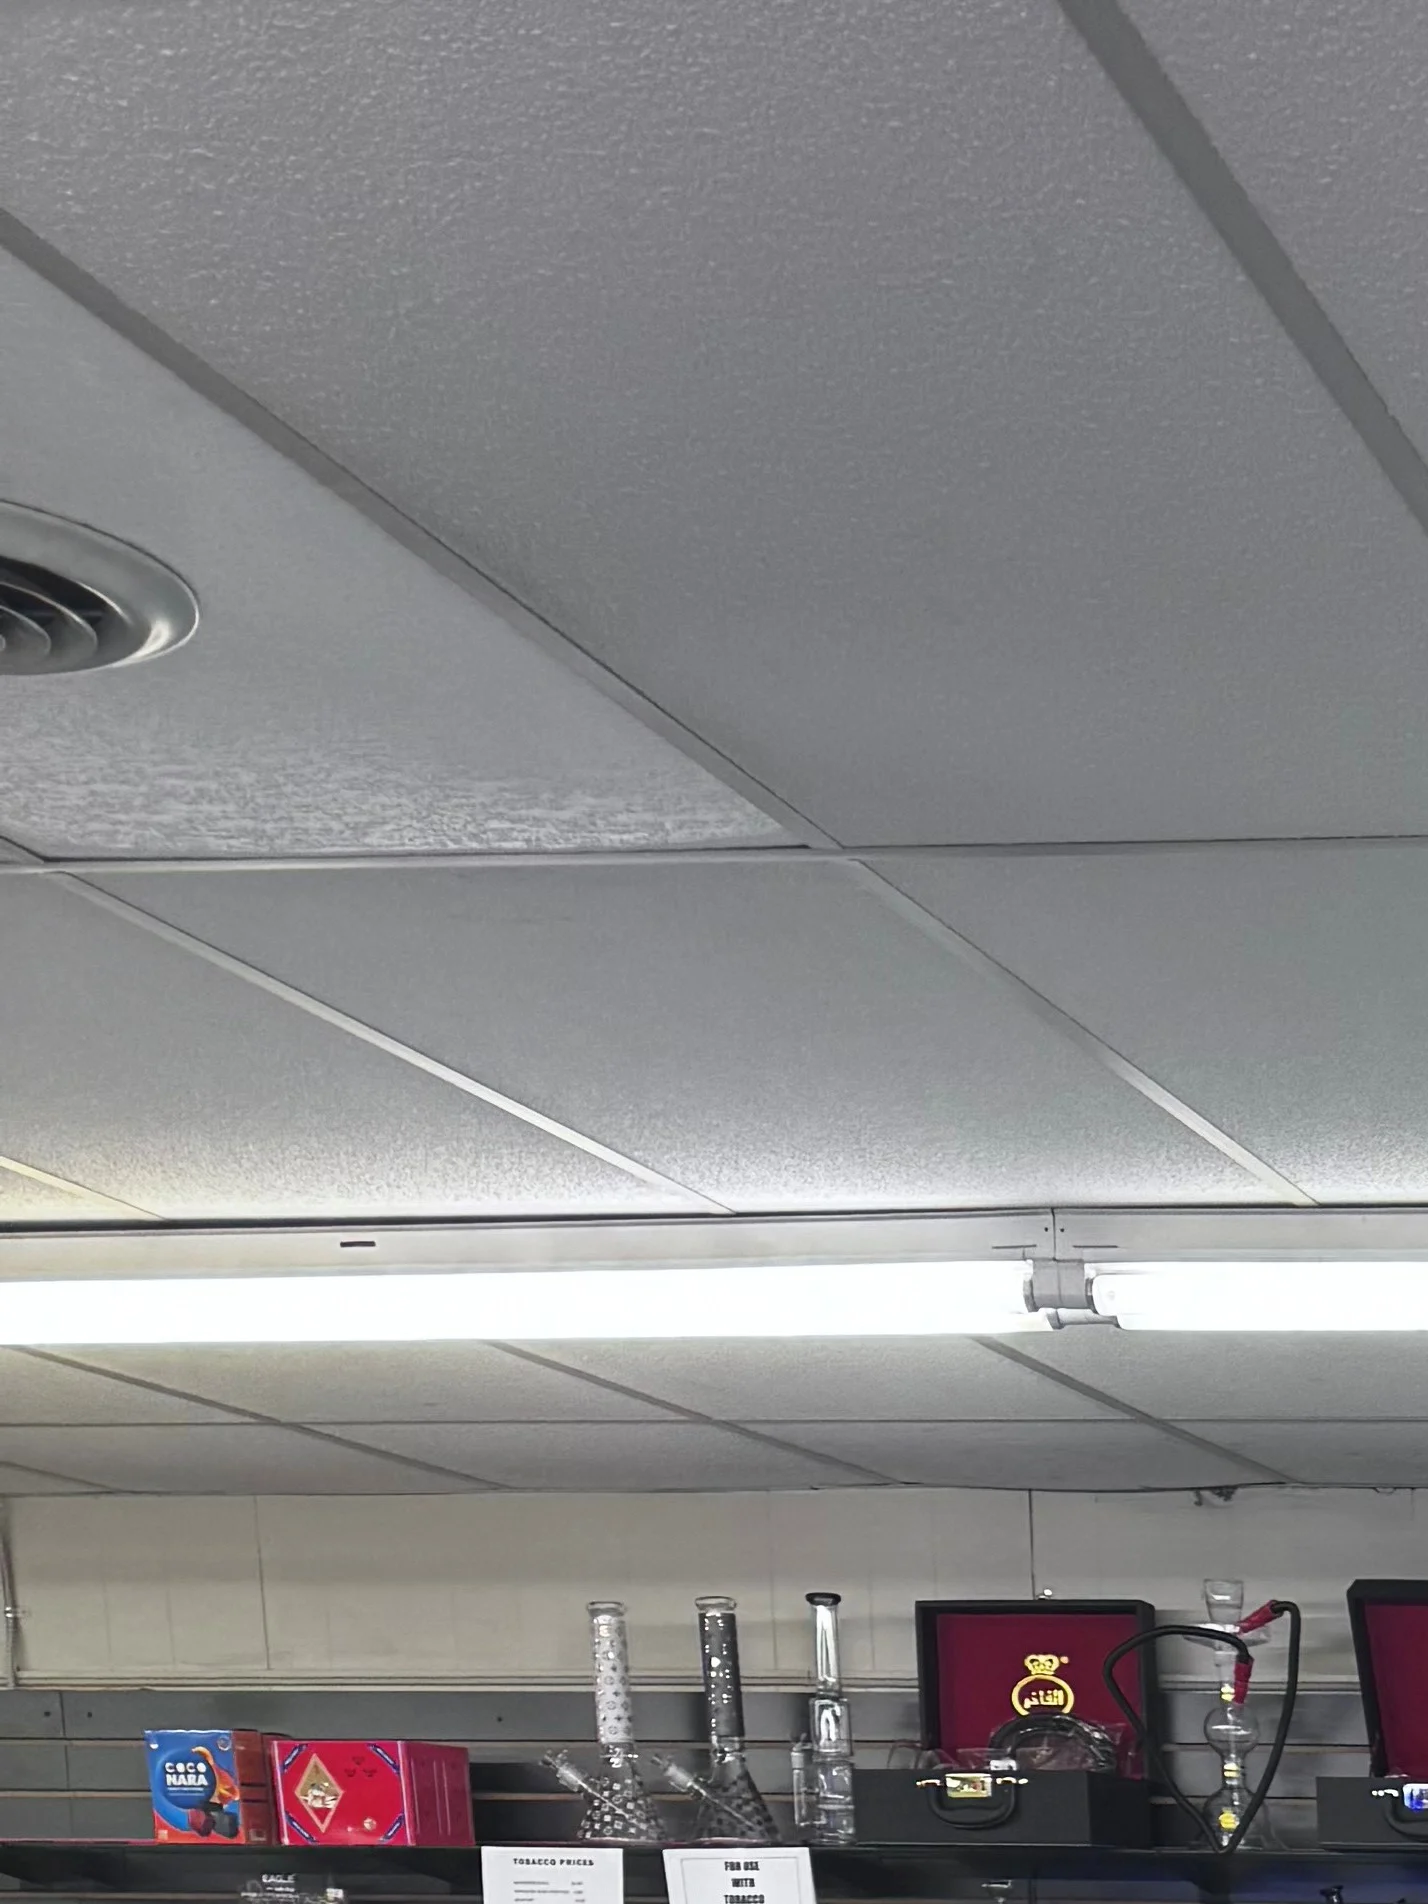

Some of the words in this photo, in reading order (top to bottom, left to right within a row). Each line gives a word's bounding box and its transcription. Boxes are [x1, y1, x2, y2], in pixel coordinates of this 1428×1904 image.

[164, 1762, 207, 1774] COCO
[165, 1774, 209, 1787] NARA
[513, 1858, 557, 1866] TOBACCO
[731, 1878, 755, 1887] WITH
[724, 1894, 765, 1904] TOBACCO
